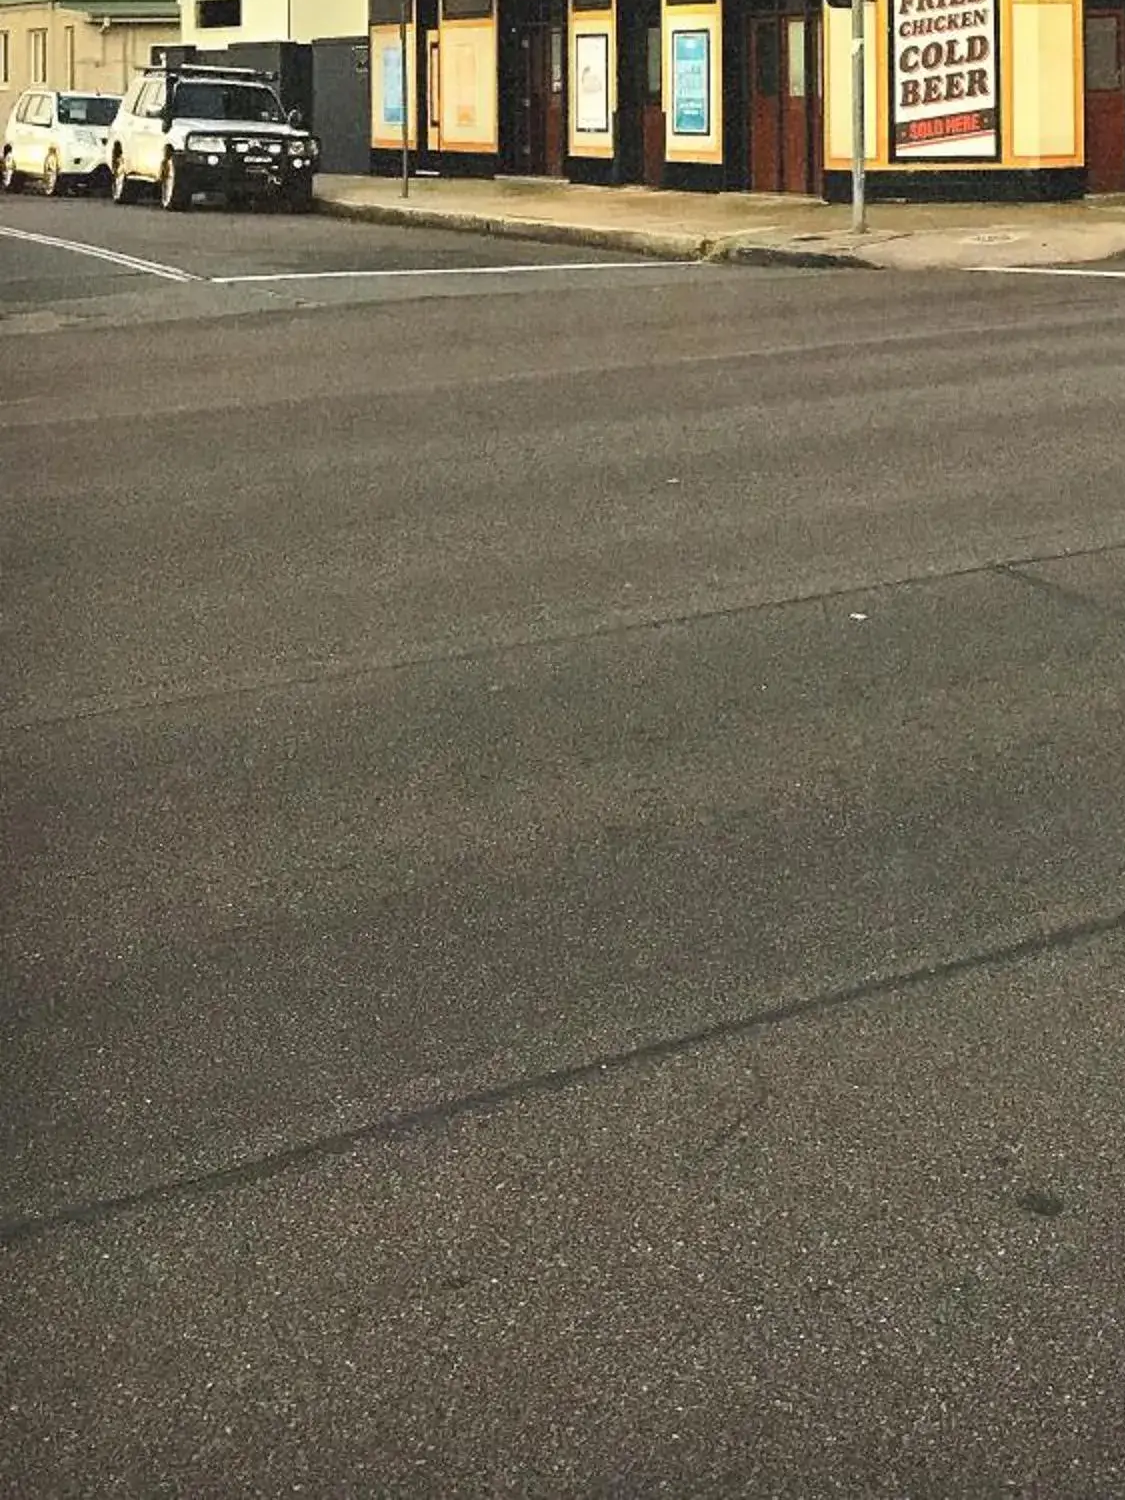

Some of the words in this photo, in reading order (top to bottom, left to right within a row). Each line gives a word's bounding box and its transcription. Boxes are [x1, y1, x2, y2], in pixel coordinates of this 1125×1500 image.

[899, 8, 990, 38] CHICKEN
[899, 34, 990, 73] COLD
[899, 67, 990, 108] BEER
[908, 117, 945, 138] SOLD
[946, 112, 982, 135] HERE
